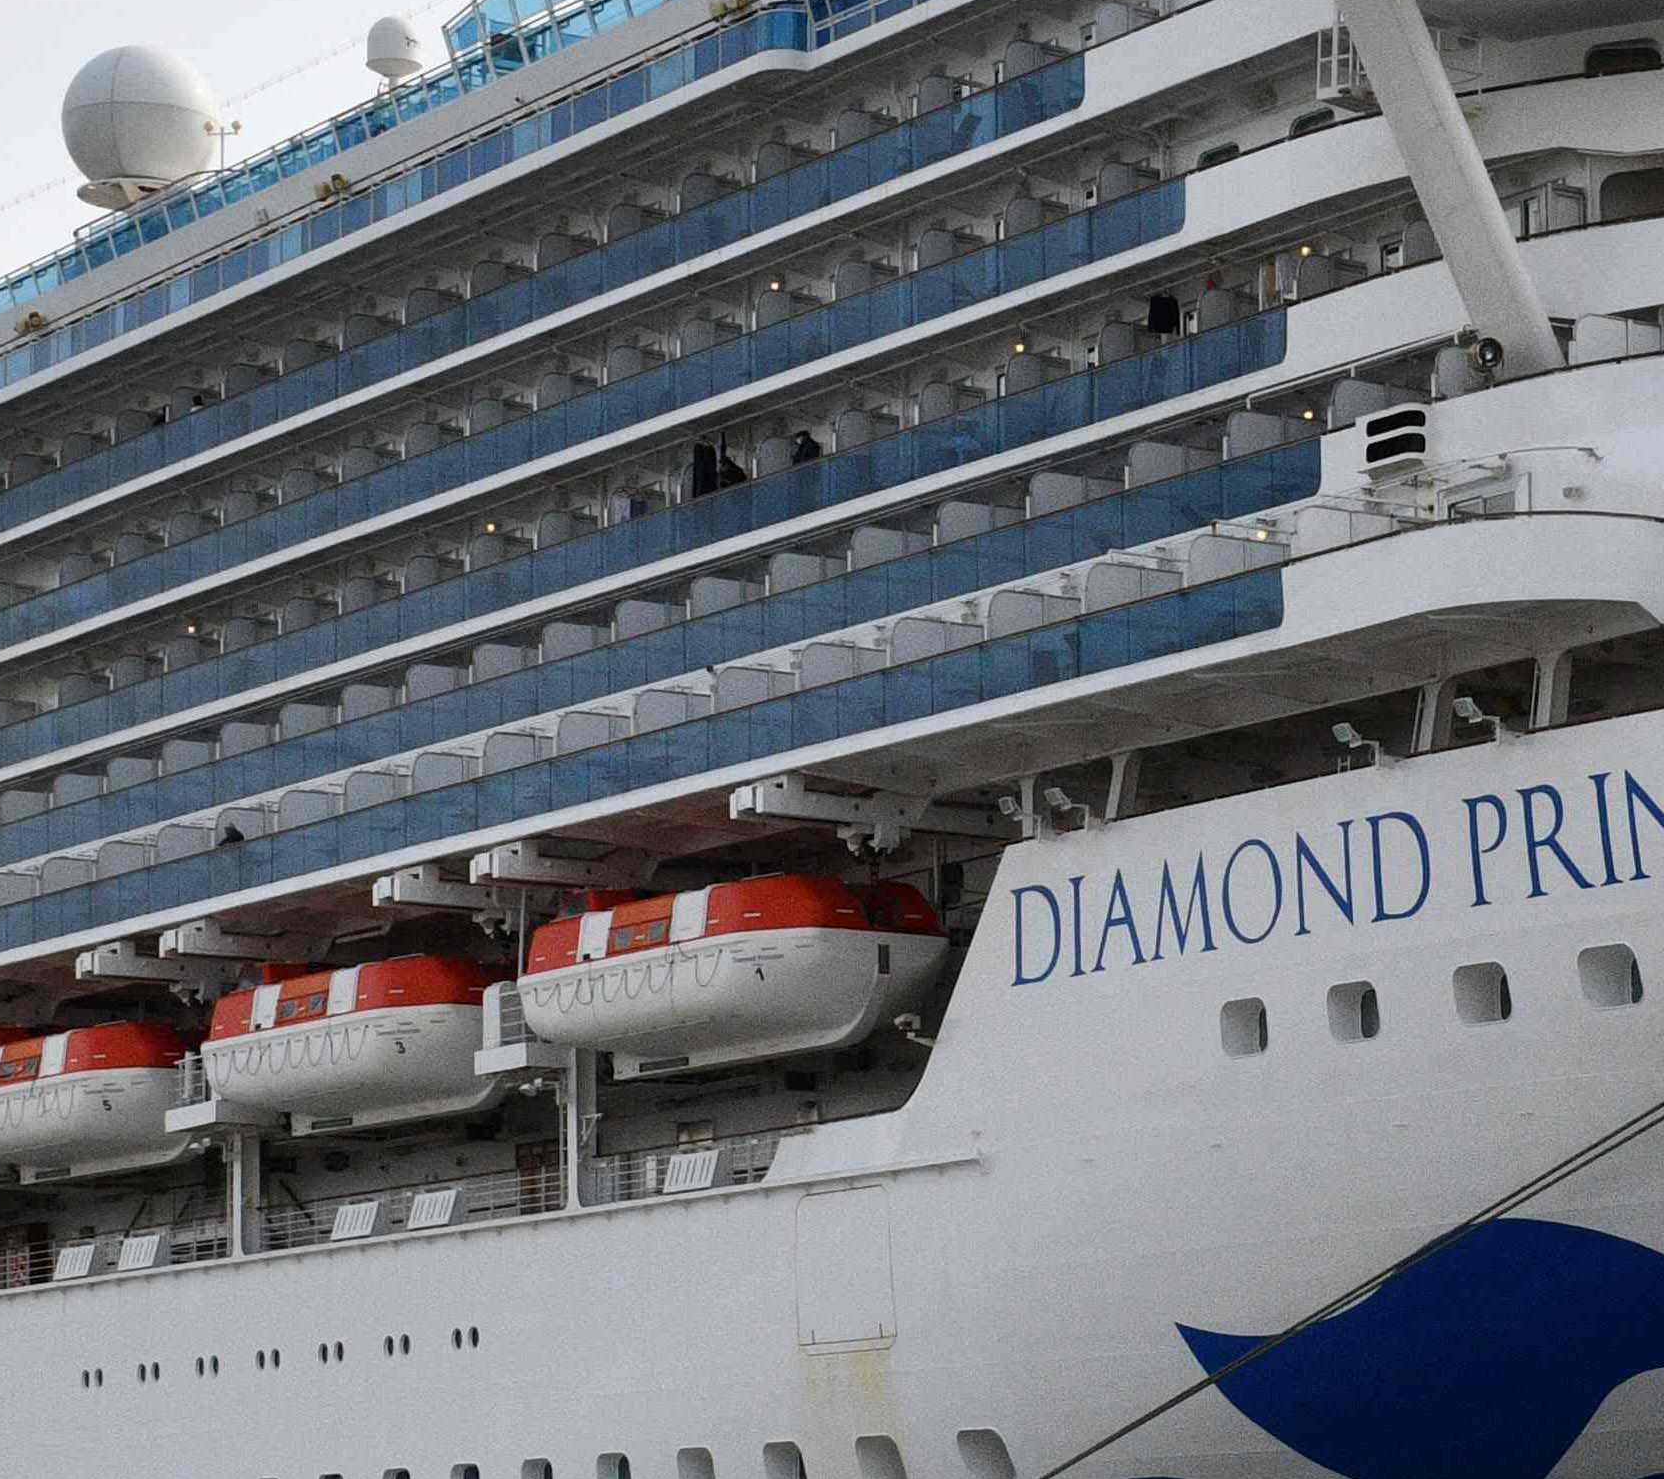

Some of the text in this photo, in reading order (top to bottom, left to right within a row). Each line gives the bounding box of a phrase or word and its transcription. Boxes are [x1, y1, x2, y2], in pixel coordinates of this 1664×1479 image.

[1009, 809, 1432, 987] DIAMOND
[394, 1040, 406, 1054] 3
[102, 1099, 113, 1111] 5
